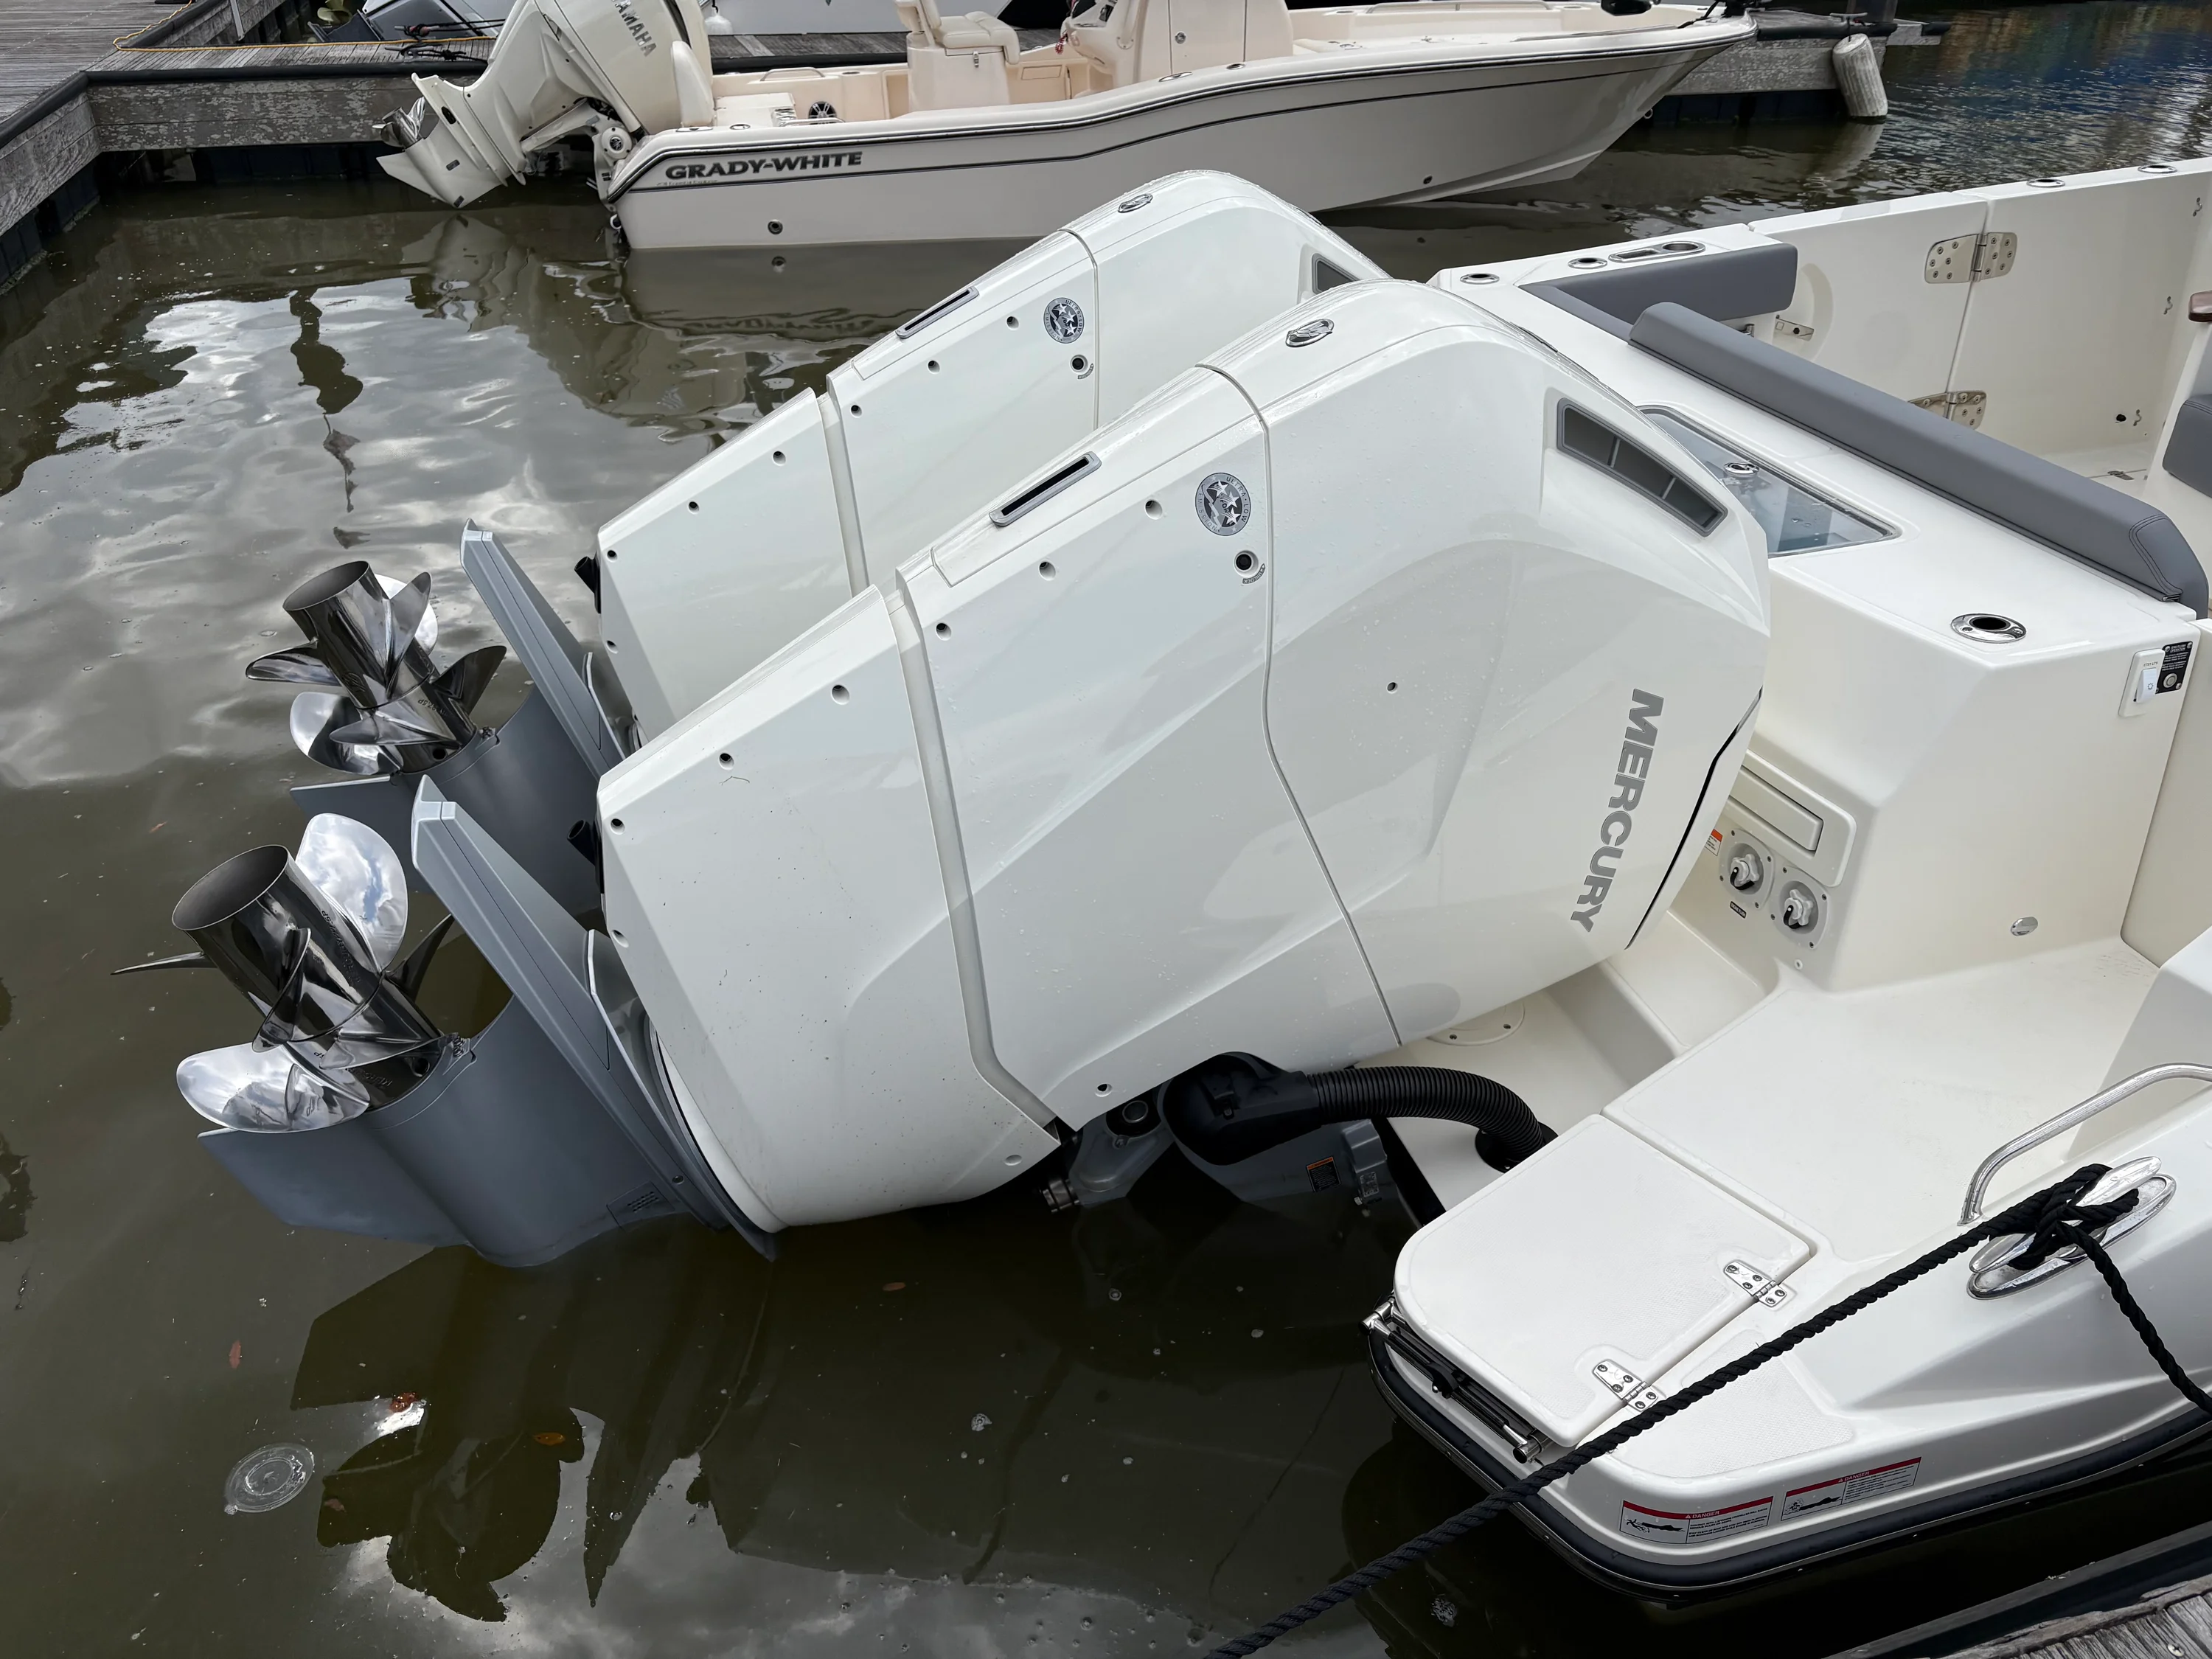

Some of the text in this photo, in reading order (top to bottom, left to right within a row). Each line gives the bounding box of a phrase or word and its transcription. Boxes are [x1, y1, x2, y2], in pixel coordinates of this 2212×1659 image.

[611, 0, 657, 58] AMAHA
[665, 151, 863, 180] GRADY-WHITE
[1226, 476, 1249, 523] ULTRA LOW
[1570, 688, 1664, 933] MERCURY
[1844, 1471, 1870, 1481] DANGER
[1691, 1510, 1720, 1519] DANGER
